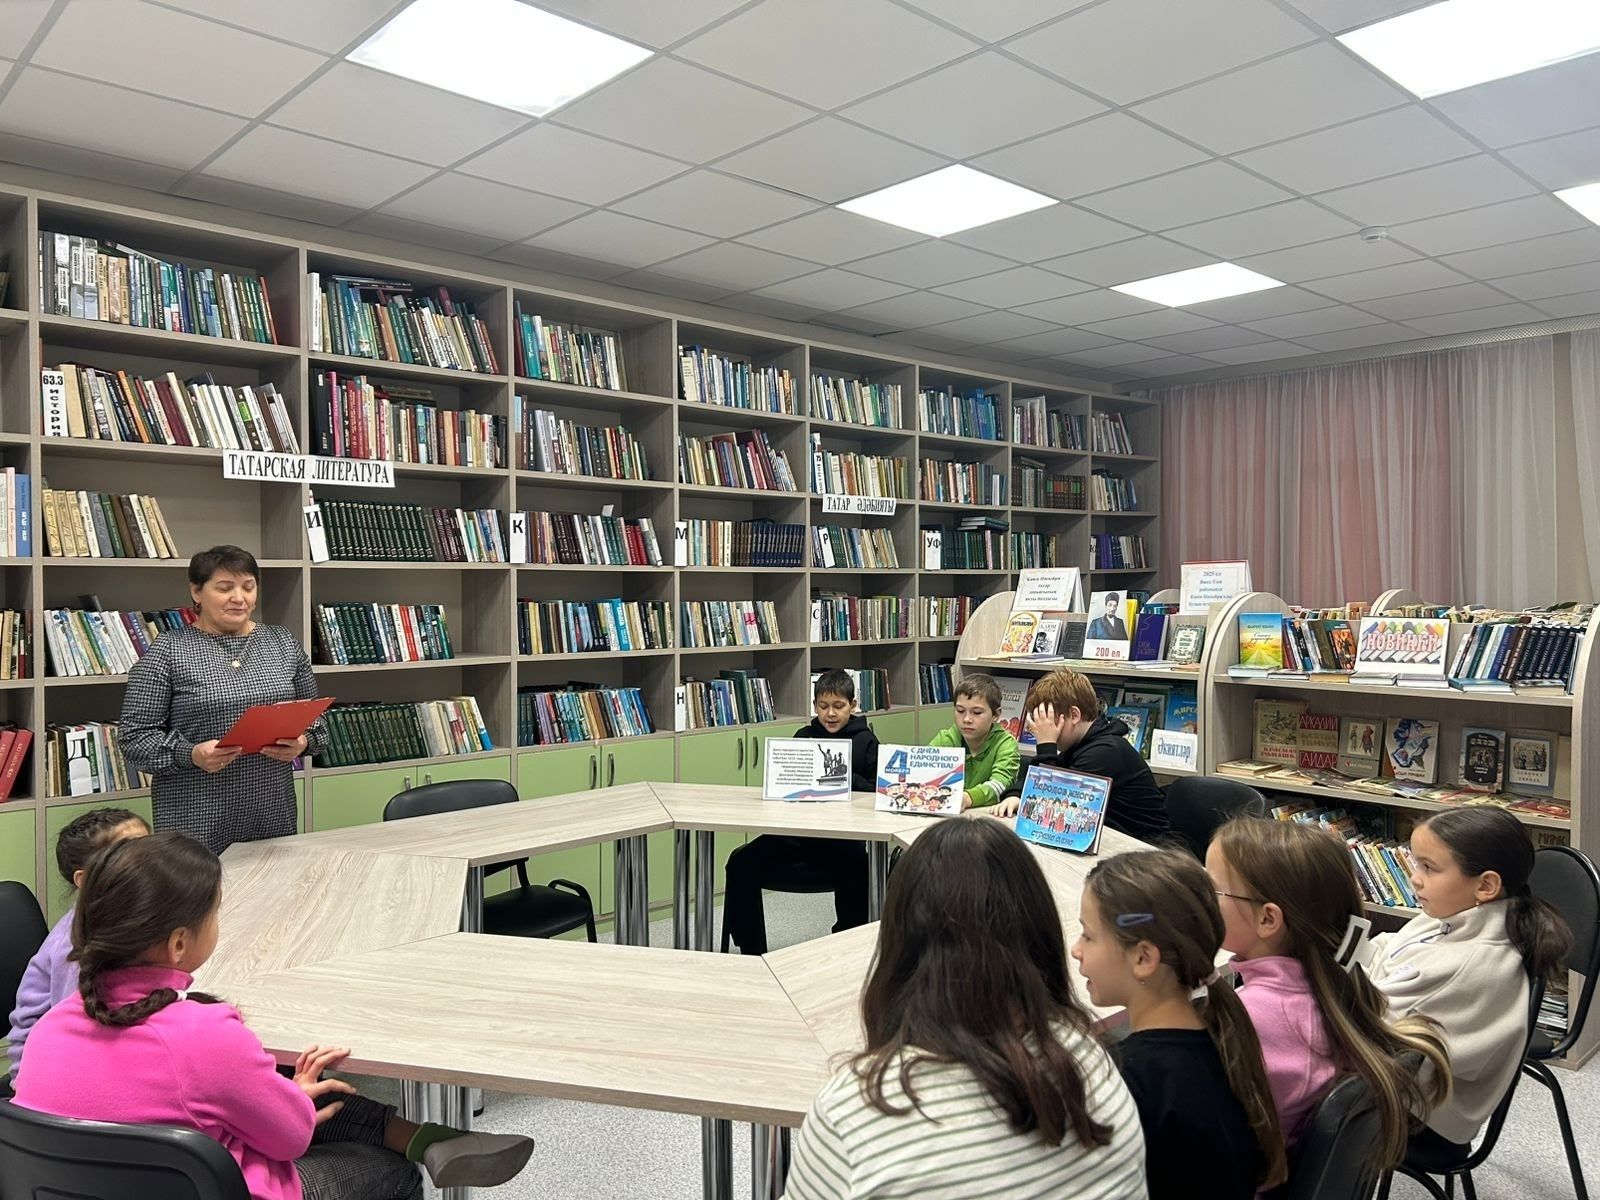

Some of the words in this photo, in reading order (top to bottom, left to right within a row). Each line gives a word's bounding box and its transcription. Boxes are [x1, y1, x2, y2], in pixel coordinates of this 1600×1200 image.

[43, 375, 64, 386] 63.3
[228, 453, 306, 479] ТАТАРСКАЯ
[312, 459, 390, 484] ЛИТЕРАТУРА
[827, 496, 851, 511] ТАТАР
[857, 497, 895, 513] ӘДӘБИЯТЫ
[304, 511, 323, 528] И
[512, 519, 524, 534] К
[675, 527, 688, 540] М
[822, 533, 829, 545] Р
[812, 608, 819, 620] С
[1366, 632, 1438, 652] НОВИНКИ
[1095, 647, 1110, 657] 200
[676, 691, 685, 705] Н
[909, 761, 954, 769] ЕДИНСТВА!
[910, 754, 959, 762] НАРОДНОГО
[884, 749, 908, 782] 4
[1032, 779, 1068, 796] Народов
